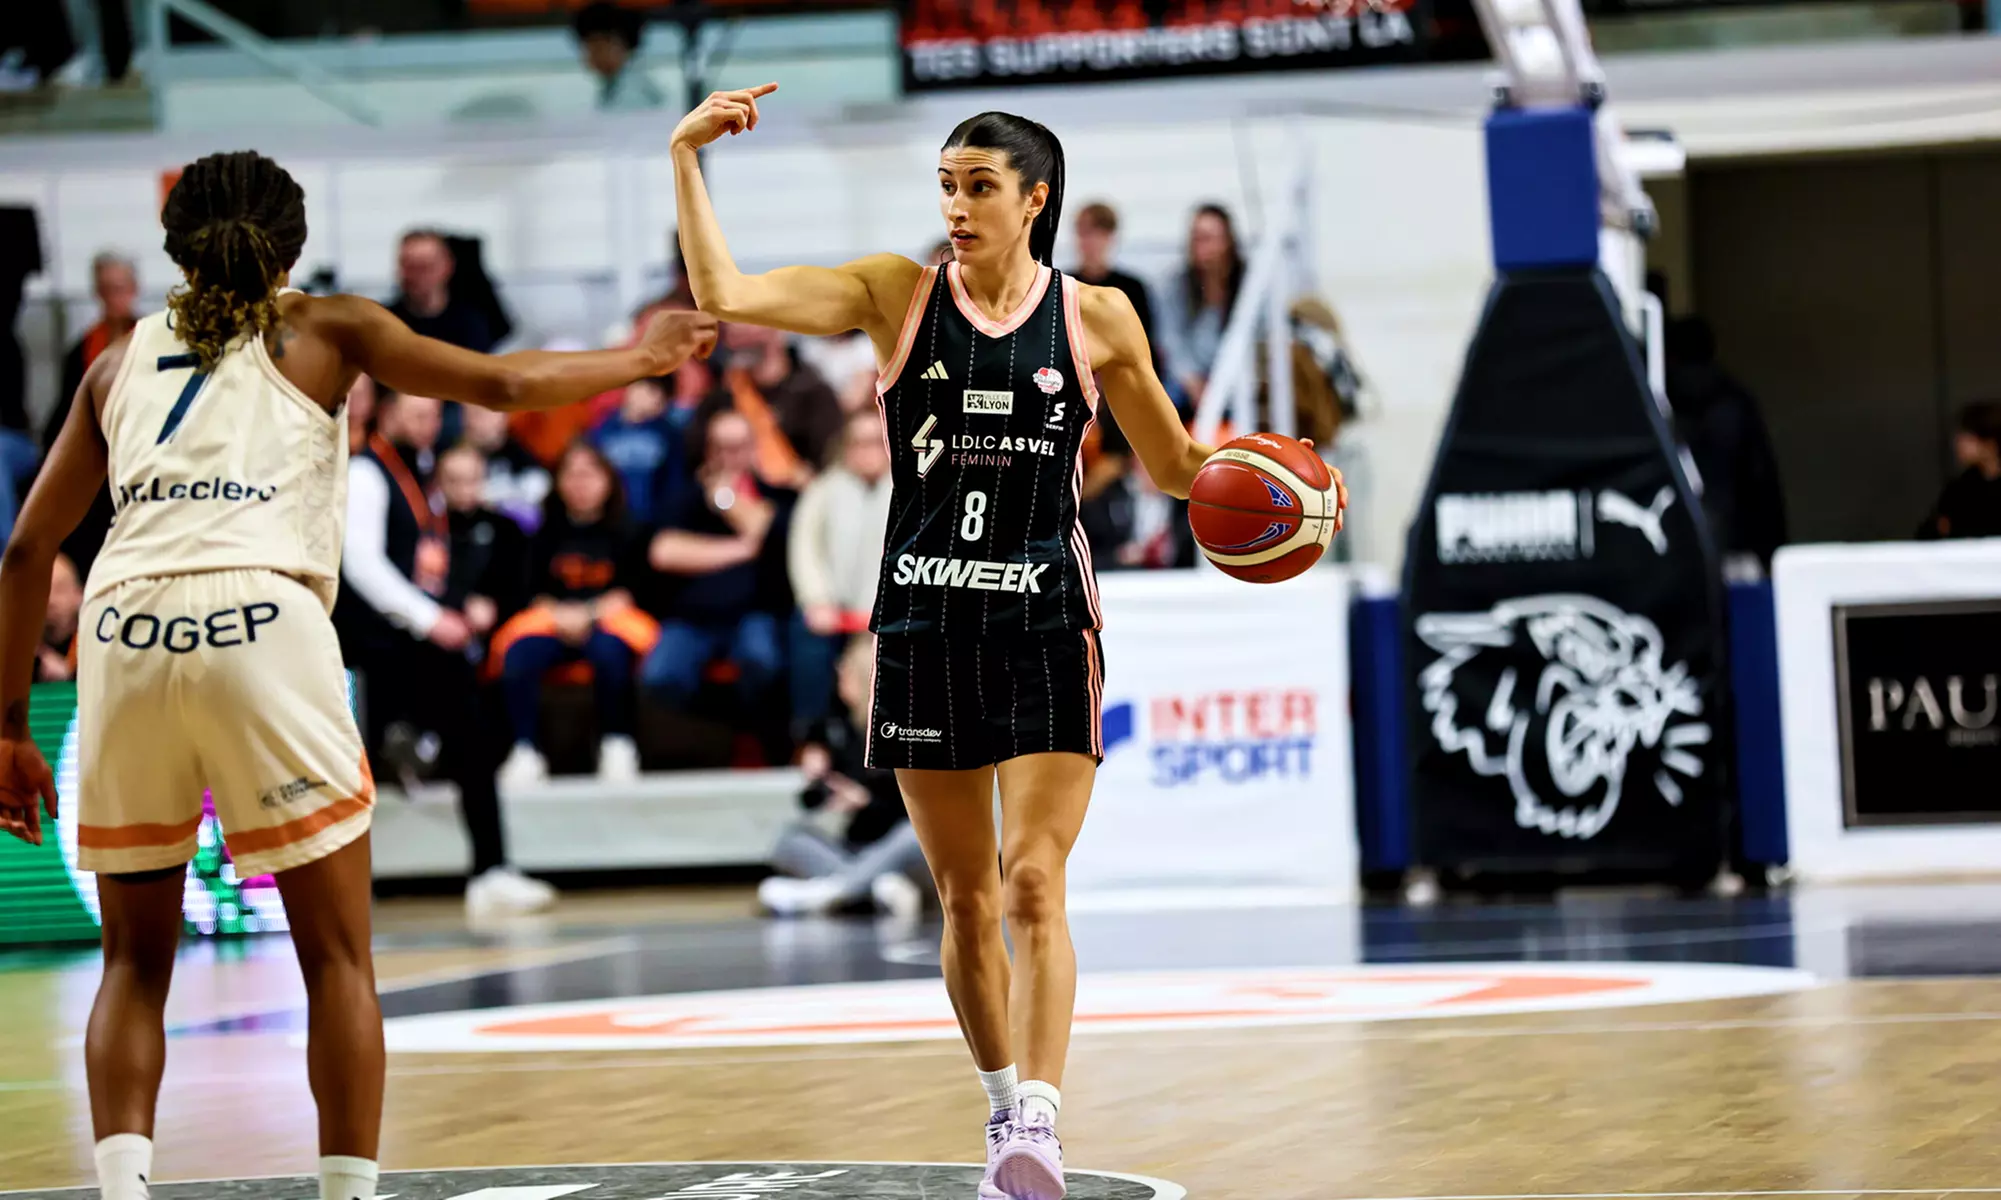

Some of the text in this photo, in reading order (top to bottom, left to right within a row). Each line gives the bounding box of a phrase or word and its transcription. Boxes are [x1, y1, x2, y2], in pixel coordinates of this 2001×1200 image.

[155, 351, 212, 446] 7
[984, 400, 1010, 410] LYON
[951, 452, 1012, 467] FÉMININ
[952, 434, 1056, 457] LDLC ASVEL
[960, 490, 987, 542] 8
[893, 553, 1050, 594] SKWEEK
[96, 602, 280, 654] COGEP
[898, 727, 942, 737] transdev
[1150, 688, 1317, 742] INTER
[1150, 735, 1313, 788] SPORT
